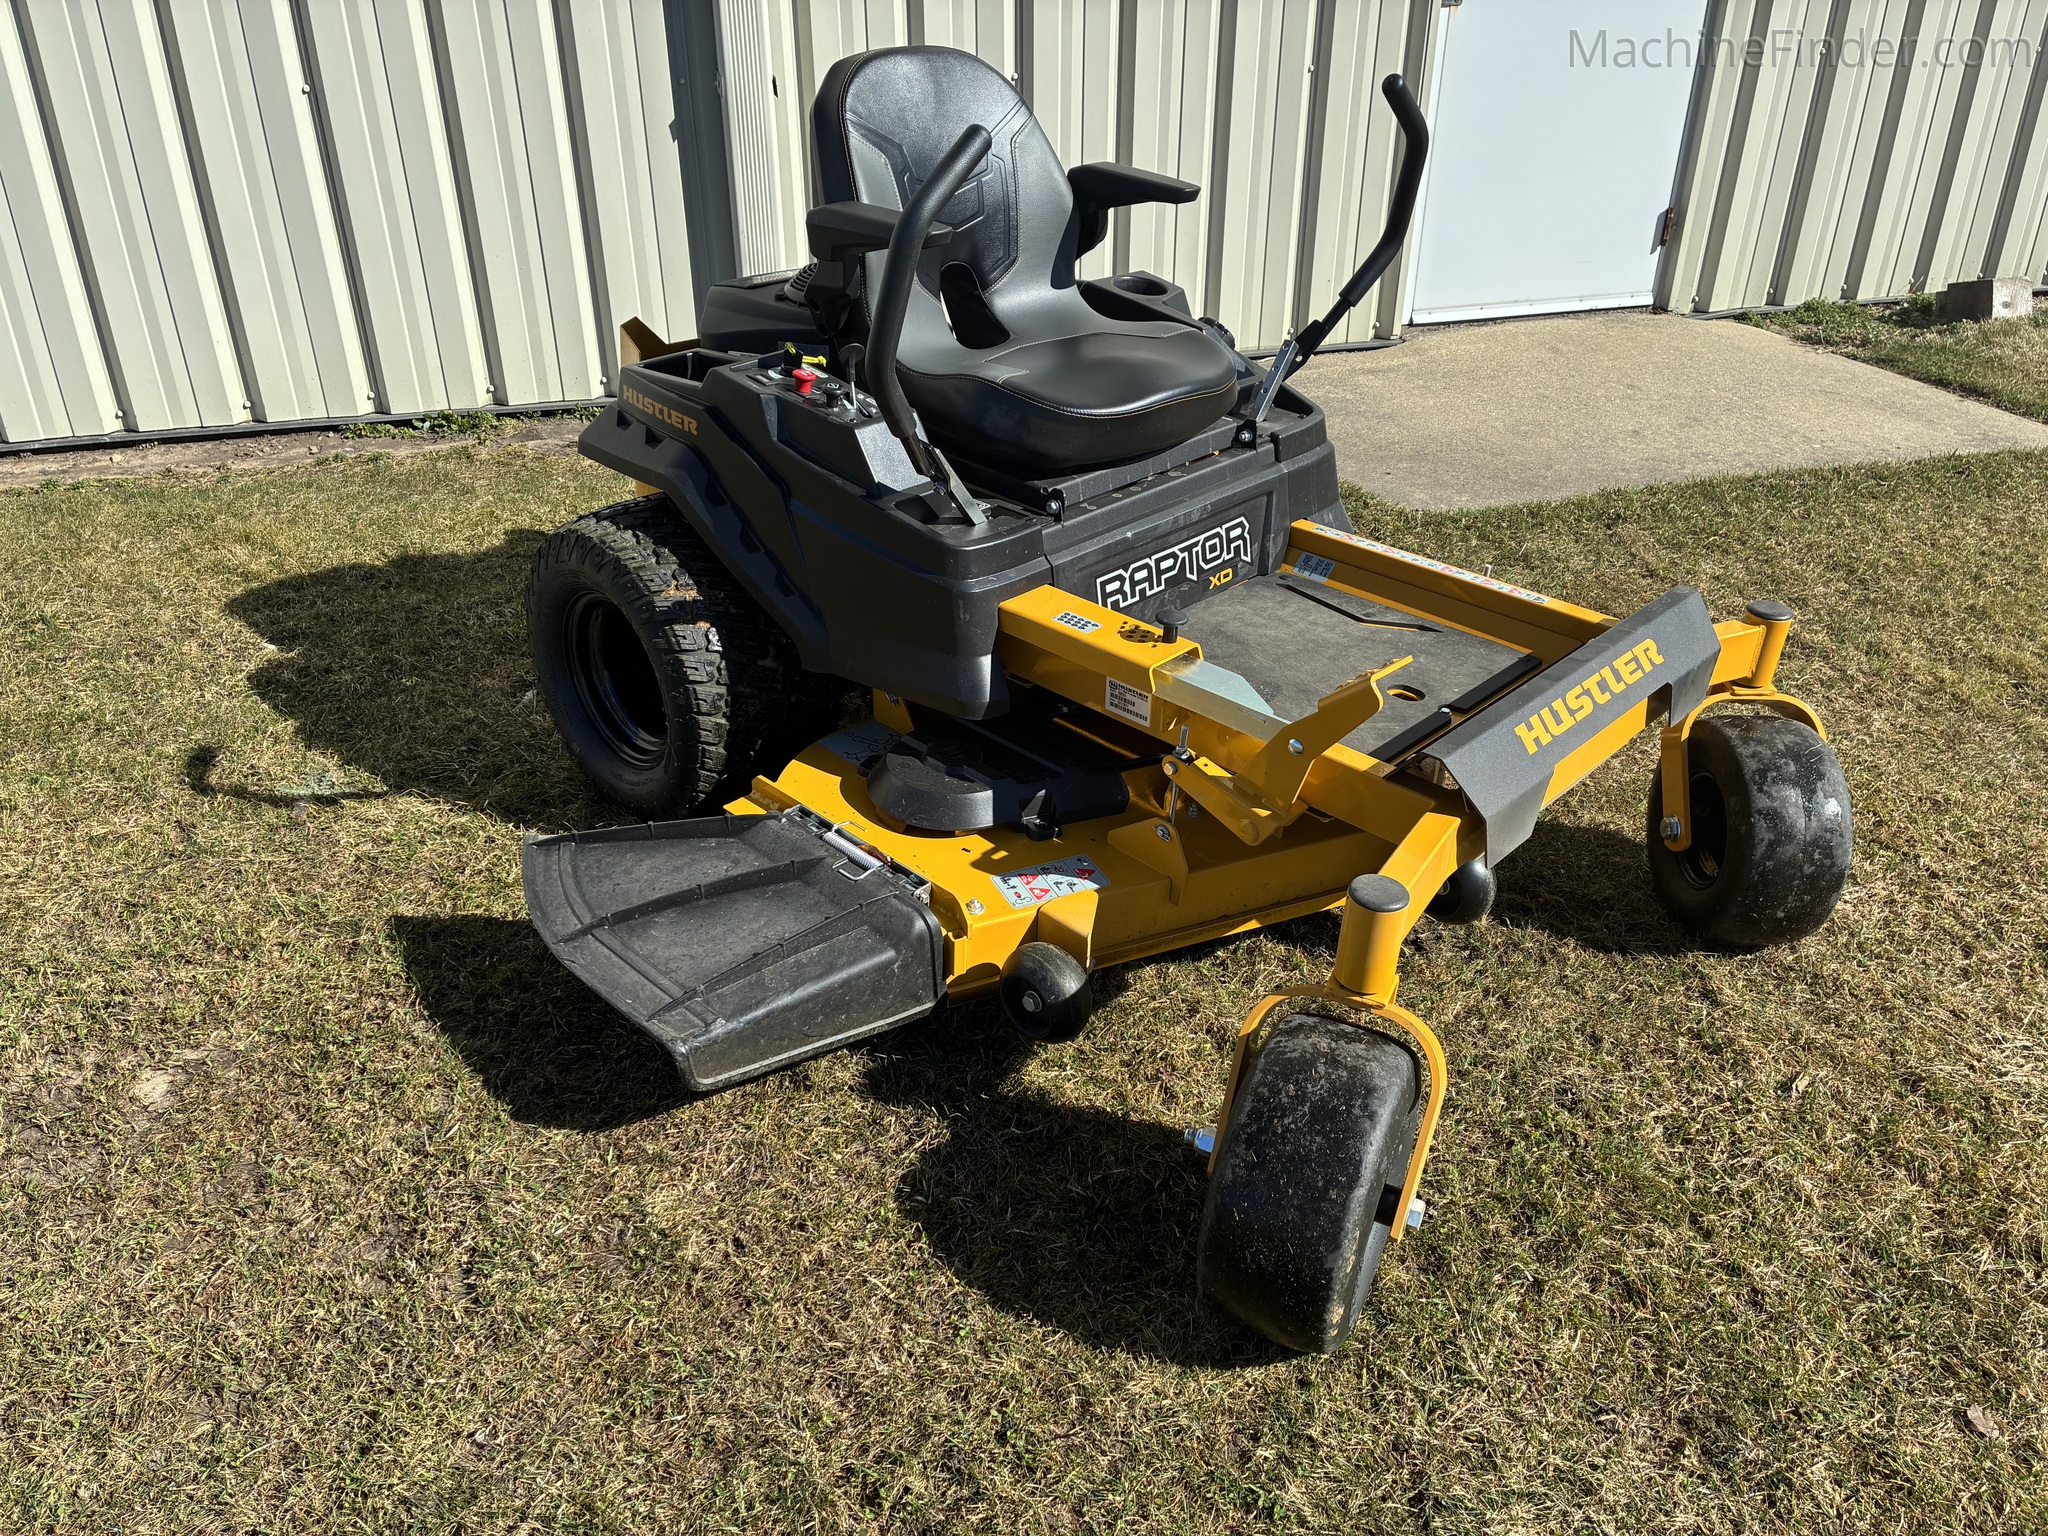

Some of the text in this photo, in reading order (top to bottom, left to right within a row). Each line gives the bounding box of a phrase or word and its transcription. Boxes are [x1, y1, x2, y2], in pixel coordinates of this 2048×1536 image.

[623, 384, 698, 435] HUSTLER
[1096, 516, 1252, 610] RAPTOR
[1208, 568, 1233, 590] XD
[1514, 638, 1665, 756] HUSTLER
